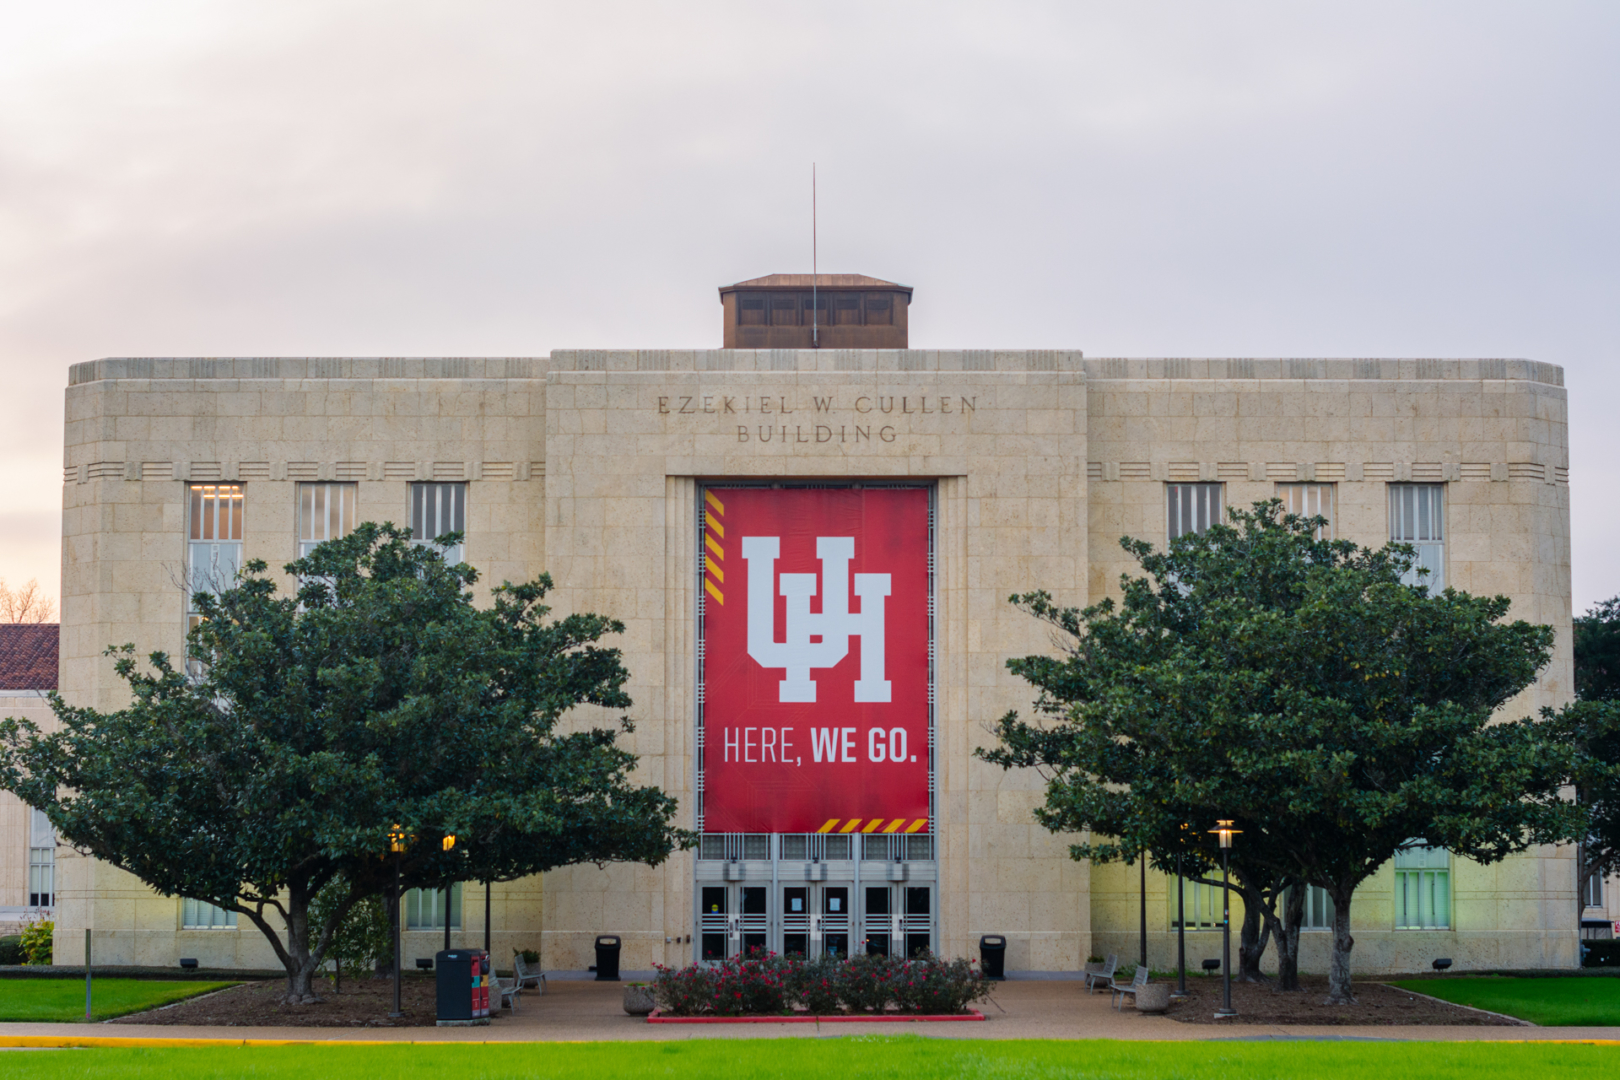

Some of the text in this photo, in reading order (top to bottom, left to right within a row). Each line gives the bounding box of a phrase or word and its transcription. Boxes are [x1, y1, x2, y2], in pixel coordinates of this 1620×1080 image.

[657, 396, 794, 414] EZEKIEL
[854, 396, 977, 414] CULLEN
[737, 425, 897, 443] BUILDING
[741, 536, 892, 703] UH
[724, 727, 917, 766] HERE, WE GO.
